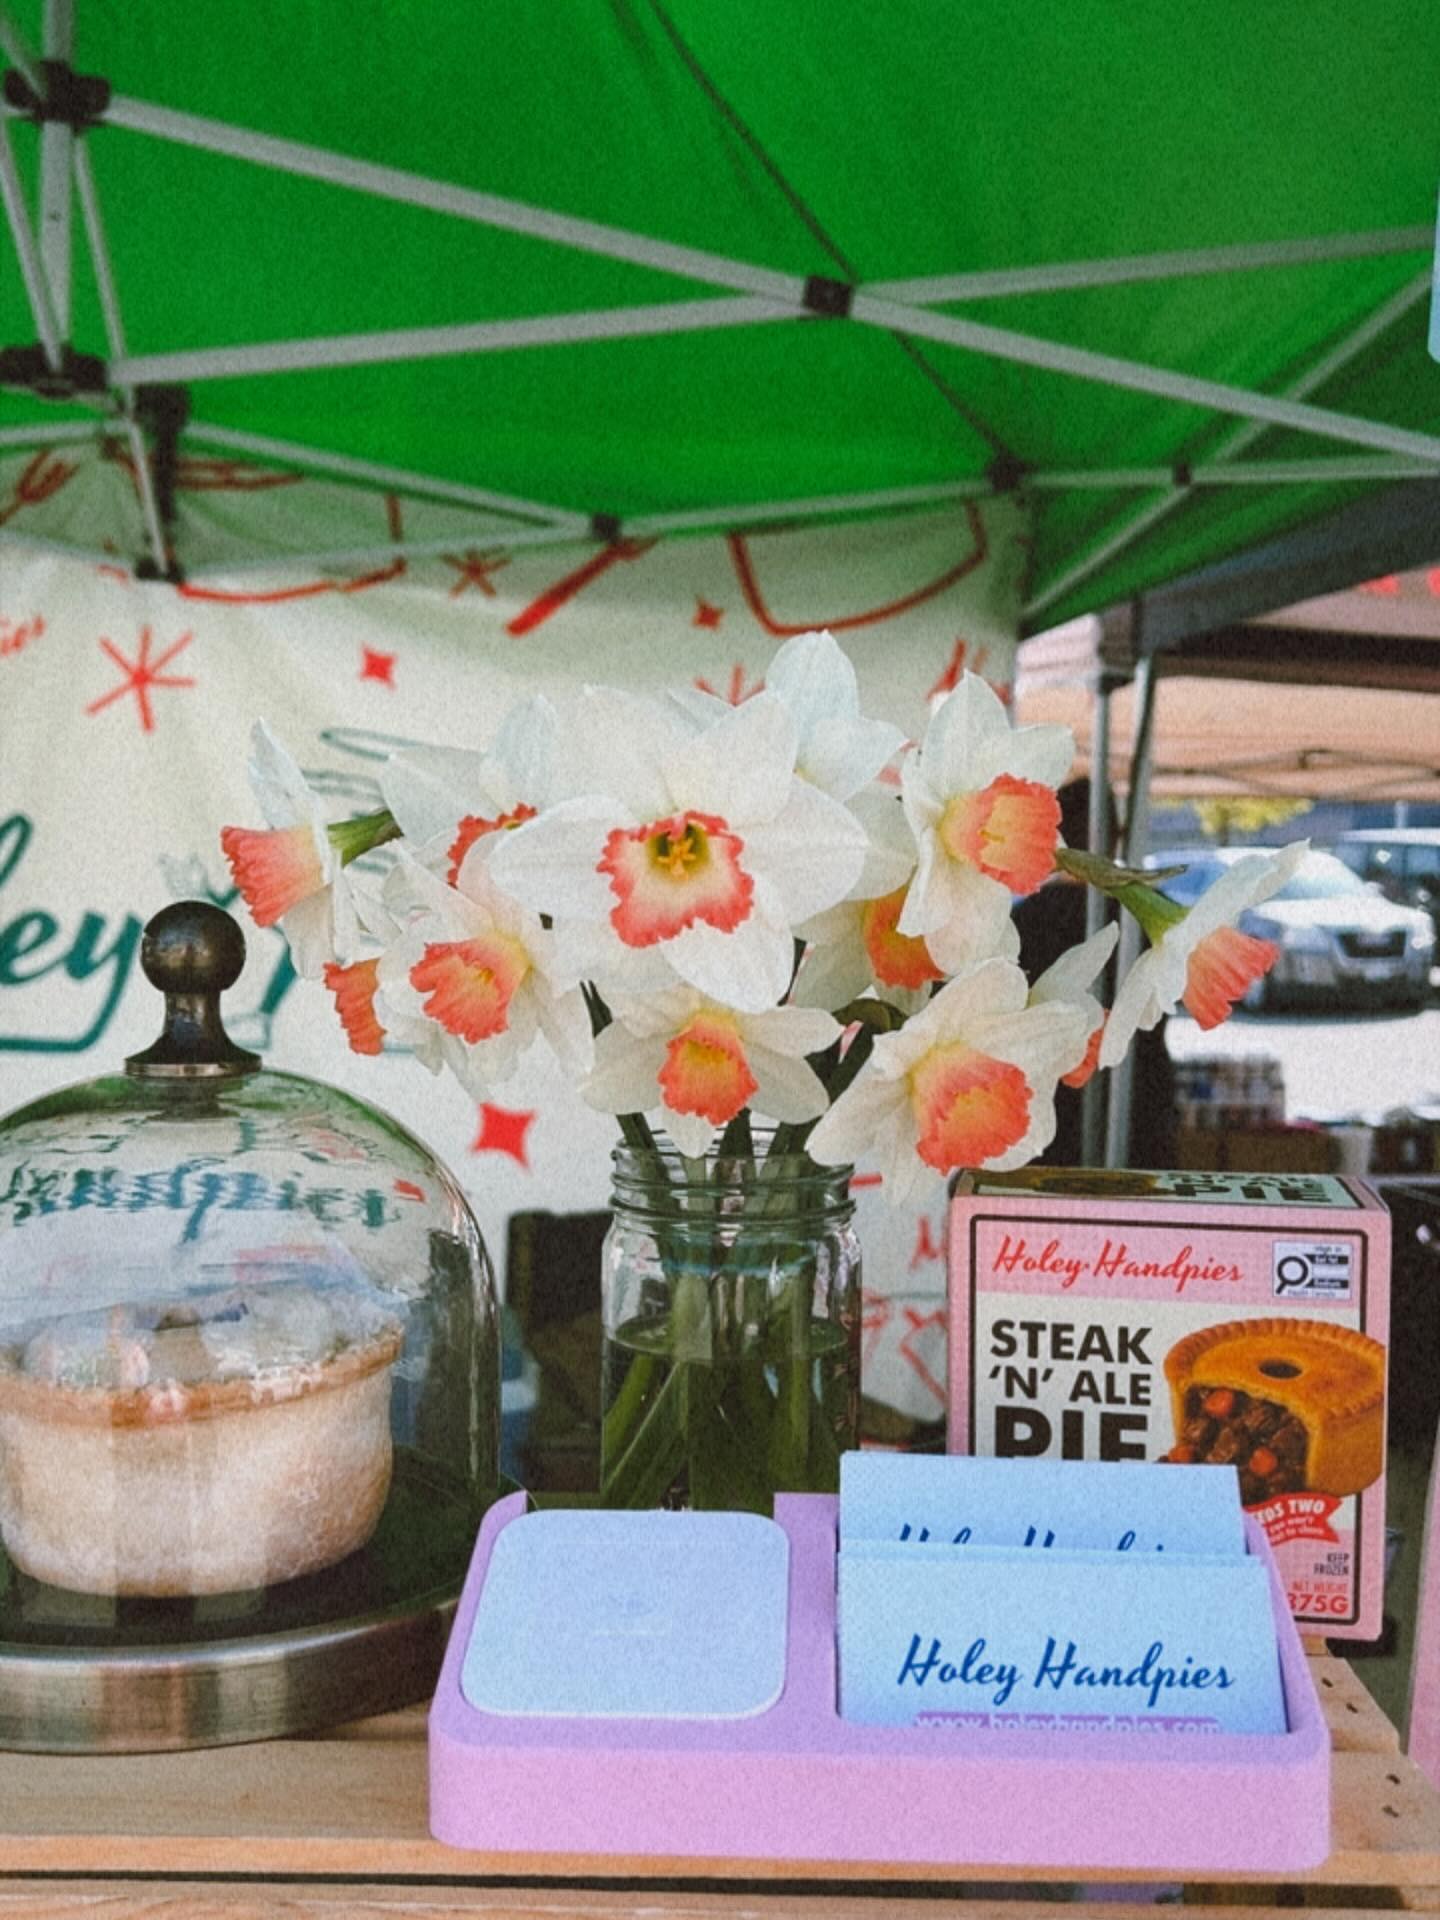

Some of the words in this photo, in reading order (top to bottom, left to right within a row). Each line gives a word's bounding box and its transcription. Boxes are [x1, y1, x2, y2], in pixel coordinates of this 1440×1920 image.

[992, 1235, 1083, 1289] Holey
[1092, 1240, 1243, 1292] Handpies
[991, 1319, 1152, 1364] STEAK
[1069, 1370, 1151, 1405] ALE
[995, 1405, 1147, 1460] PIE
[1287, 1498, 1325, 1515] TWO
[1314, 1563, 1349, 1575] FROZEN
[1328, 1552, 1349, 1563] KEEP
[897, 1633, 1022, 1706] Holey
[1034, 1635, 1236, 1708] Handpies
[914, 1711, 1220, 1733] wwwholeyhandpiescom
